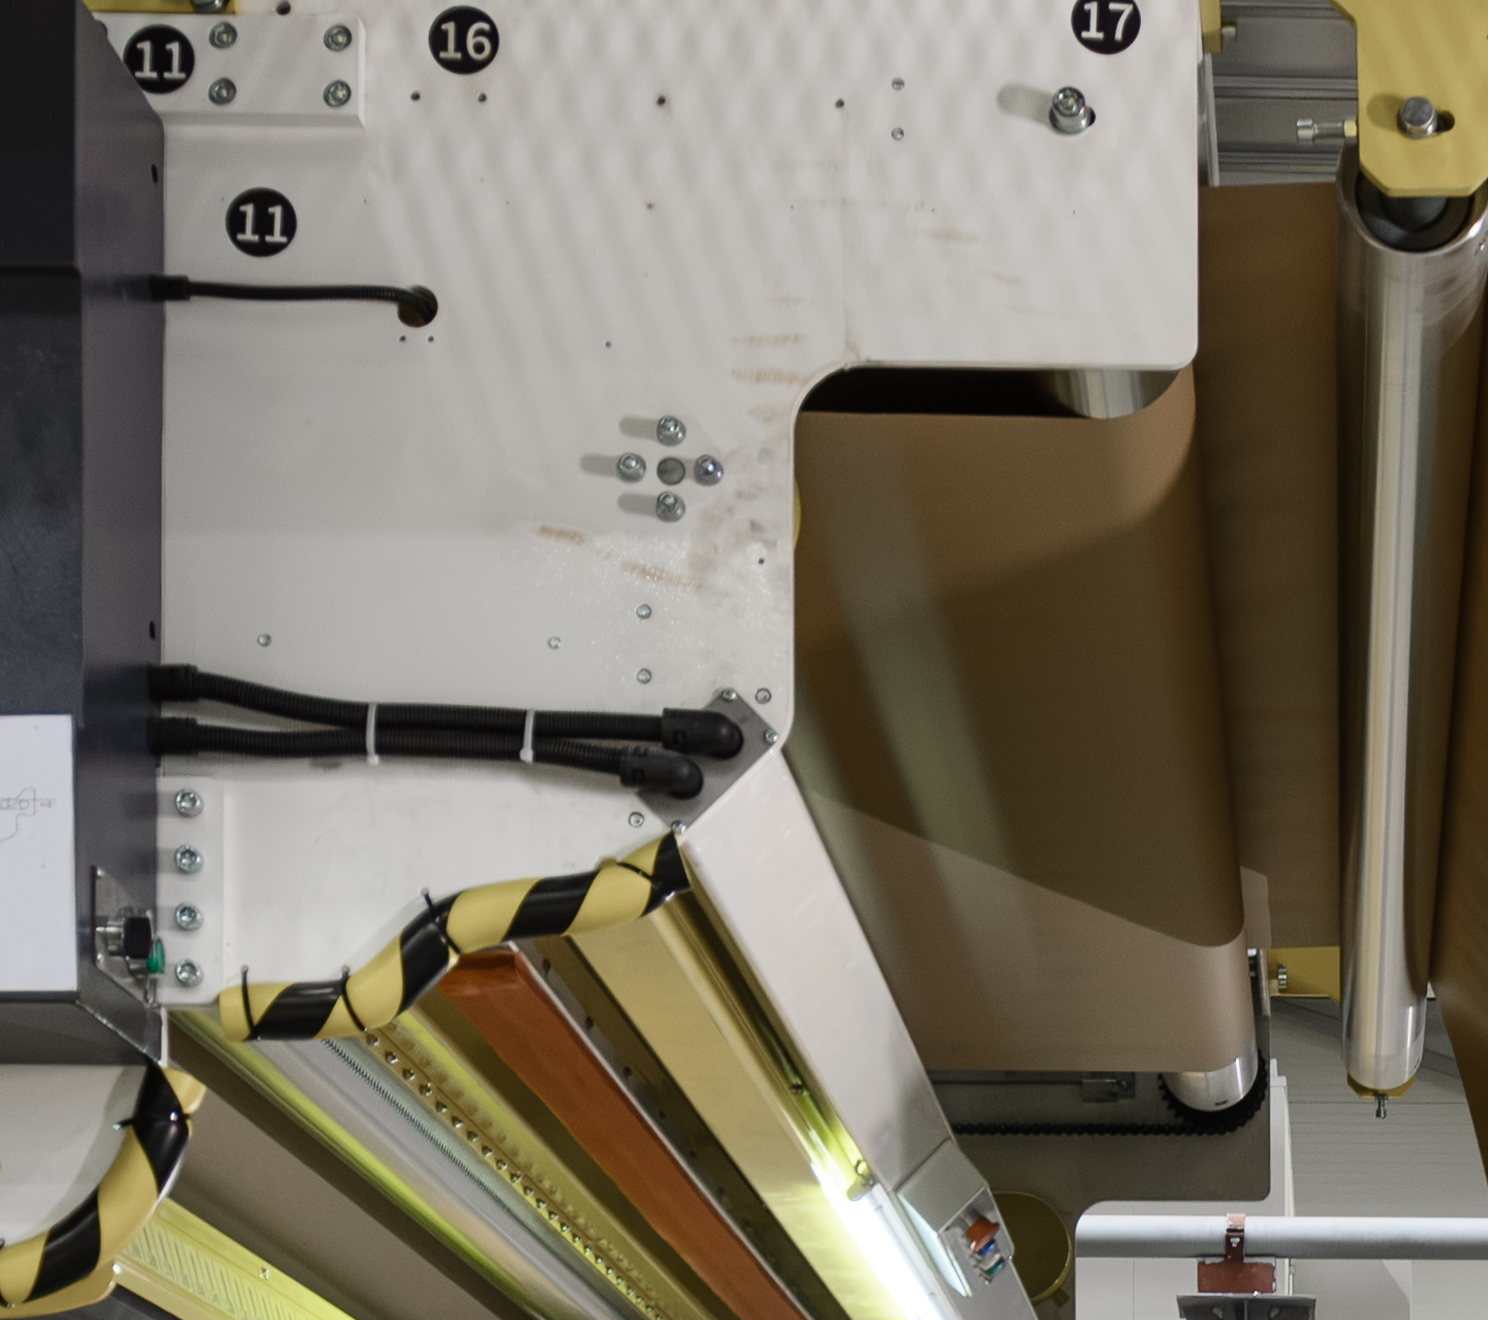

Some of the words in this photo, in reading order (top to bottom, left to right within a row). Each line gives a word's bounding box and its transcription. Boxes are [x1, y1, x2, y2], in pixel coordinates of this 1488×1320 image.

[439, 21, 493, 61] 16
[1081, 1, 1133, 41] 17
[134, 40, 186, 80] 11
[236, 203, 288, 243] 11
